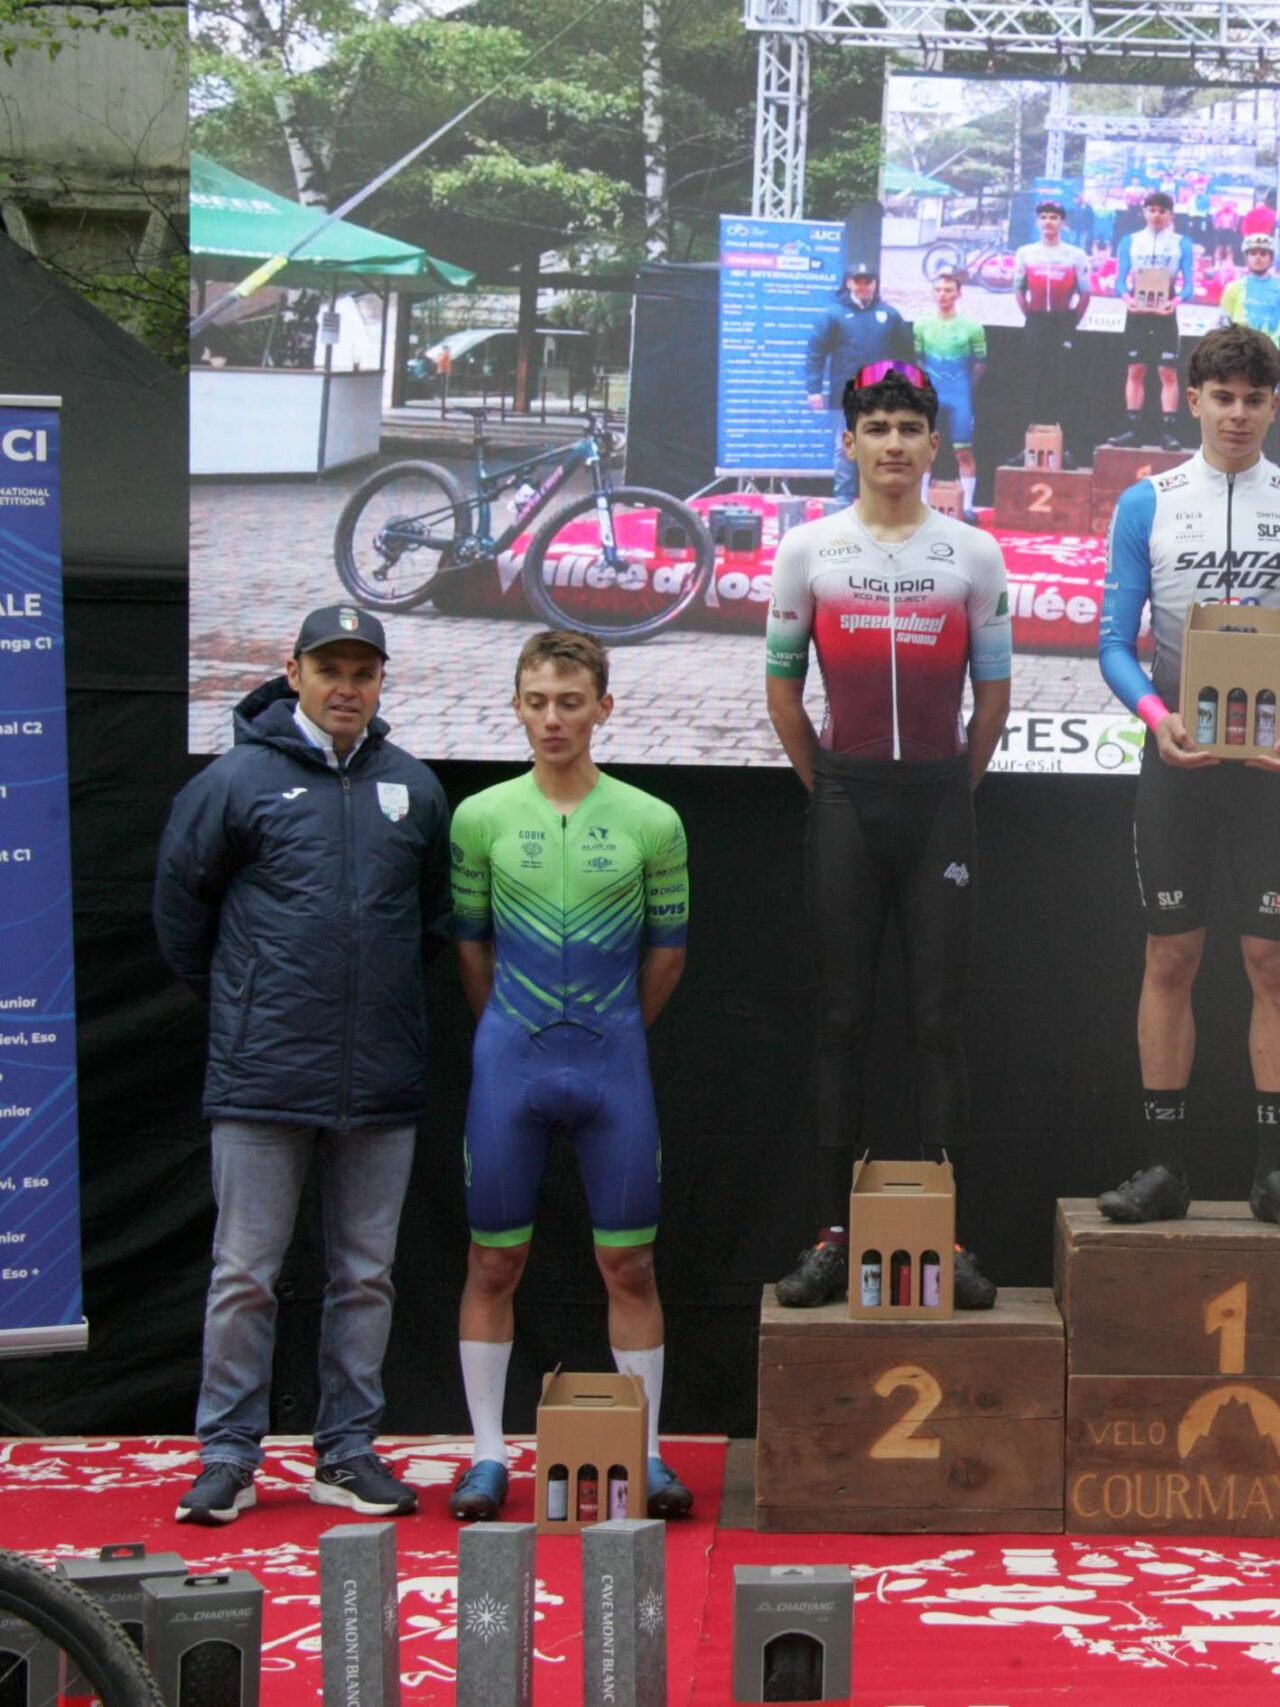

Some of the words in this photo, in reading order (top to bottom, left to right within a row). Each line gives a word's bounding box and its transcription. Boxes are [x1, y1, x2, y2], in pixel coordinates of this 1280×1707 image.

[1028, 483, 1053, 512] 2
[819, 544, 862, 557] COPES
[849, 576, 935, 594] LIGURIA
[840, 612, 947, 634] speedwheel
[35, 637, 52, 650] C1
[22, 721, 43, 734] C2
[13, 849, 31, 861] C1
[1157, 890, 1184, 907] SLP
[31, 1032, 57, 1044] Eso
[23, 1177, 49, 1188] Eso
[2, 1268, 28, 1280] Eso
[1205, 1280, 1247, 1374] 1
[869, 1365, 943, 1459] 2
[1087, 1421, 1167, 1446] VELO
[343, 1579, 358, 1615] CAVE
[602, 1574, 614, 1612] CAVE
[193, 1607, 254, 1621] CHAOYANG
[345, 1617, 359, 1662] MONT
[602, 1613, 615, 1656] MONT
[346, 1664, 360, 1707] BLANC
[602, 1657, 616, 1703] BLANC
